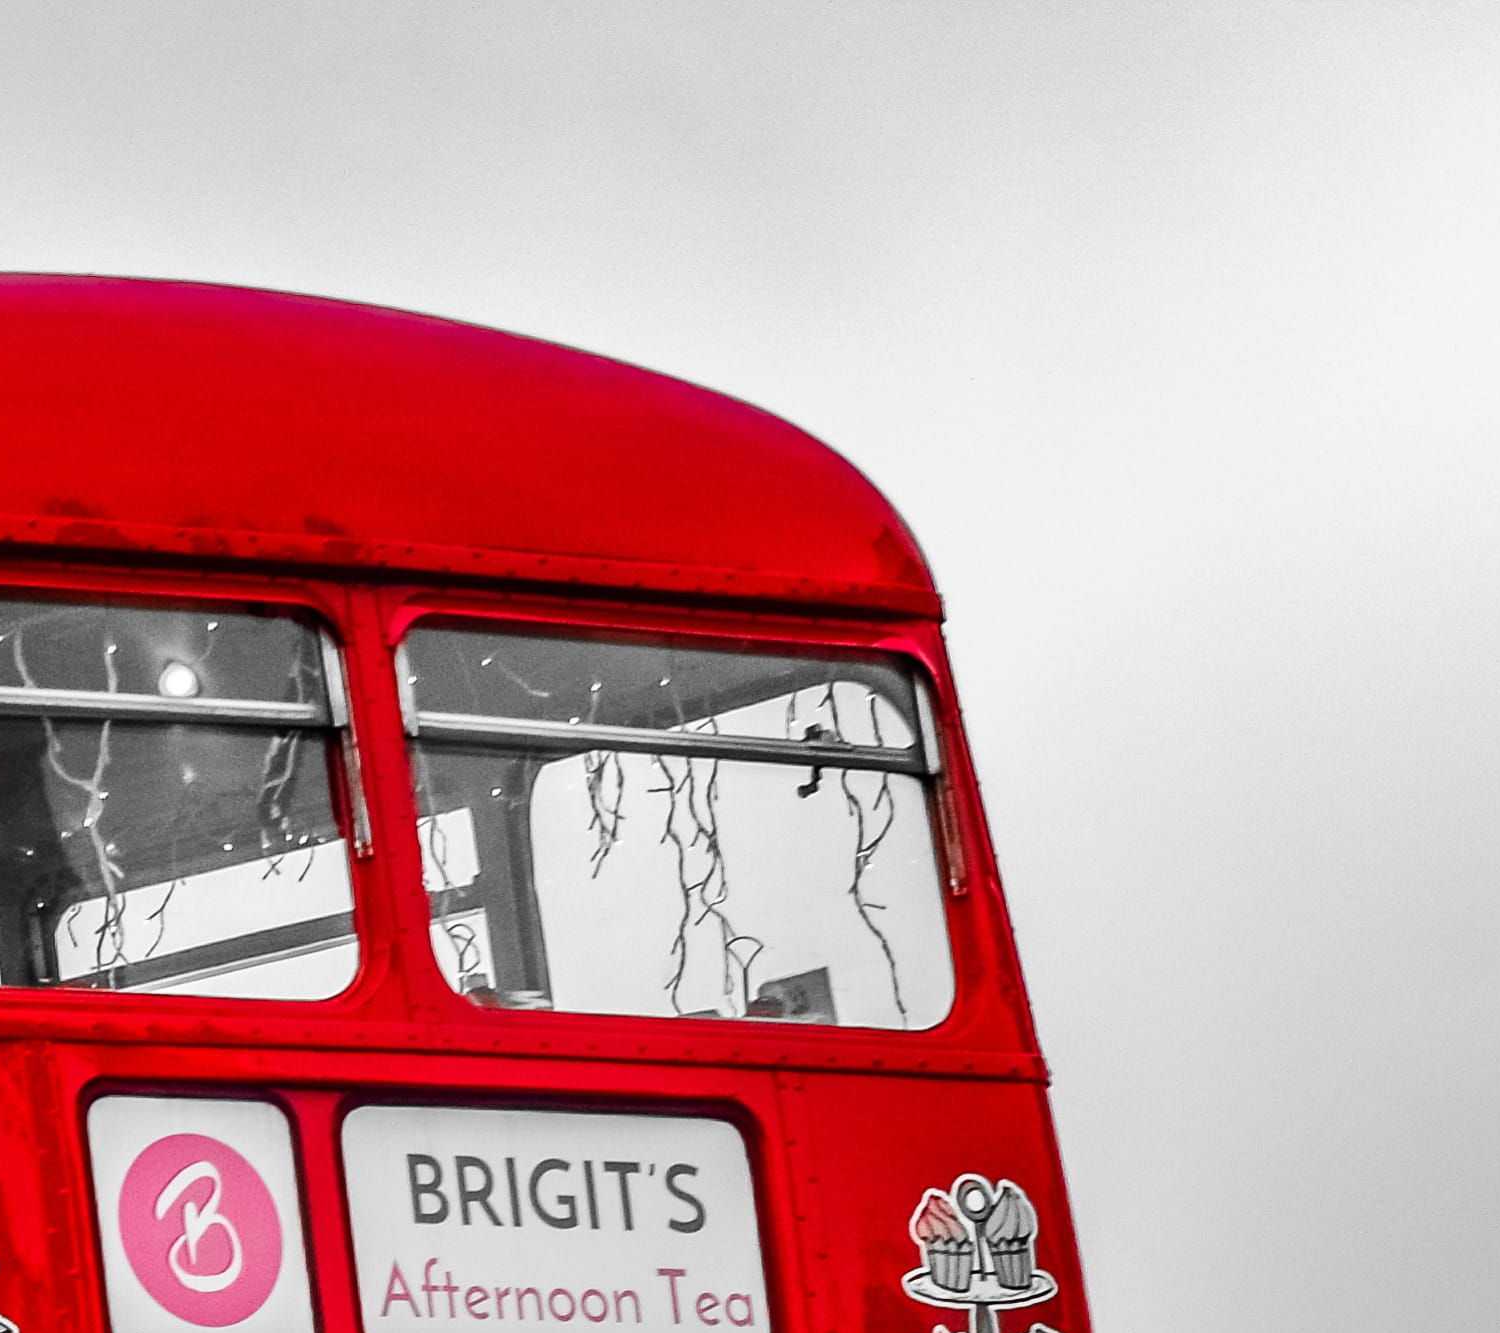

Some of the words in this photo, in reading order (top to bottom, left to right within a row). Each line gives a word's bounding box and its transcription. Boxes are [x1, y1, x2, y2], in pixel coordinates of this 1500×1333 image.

[407, 1153, 707, 1234] BRIGIT'S
[380, 1258, 643, 1325] Afternoon
[656, 1267, 755, 1328] Tea
